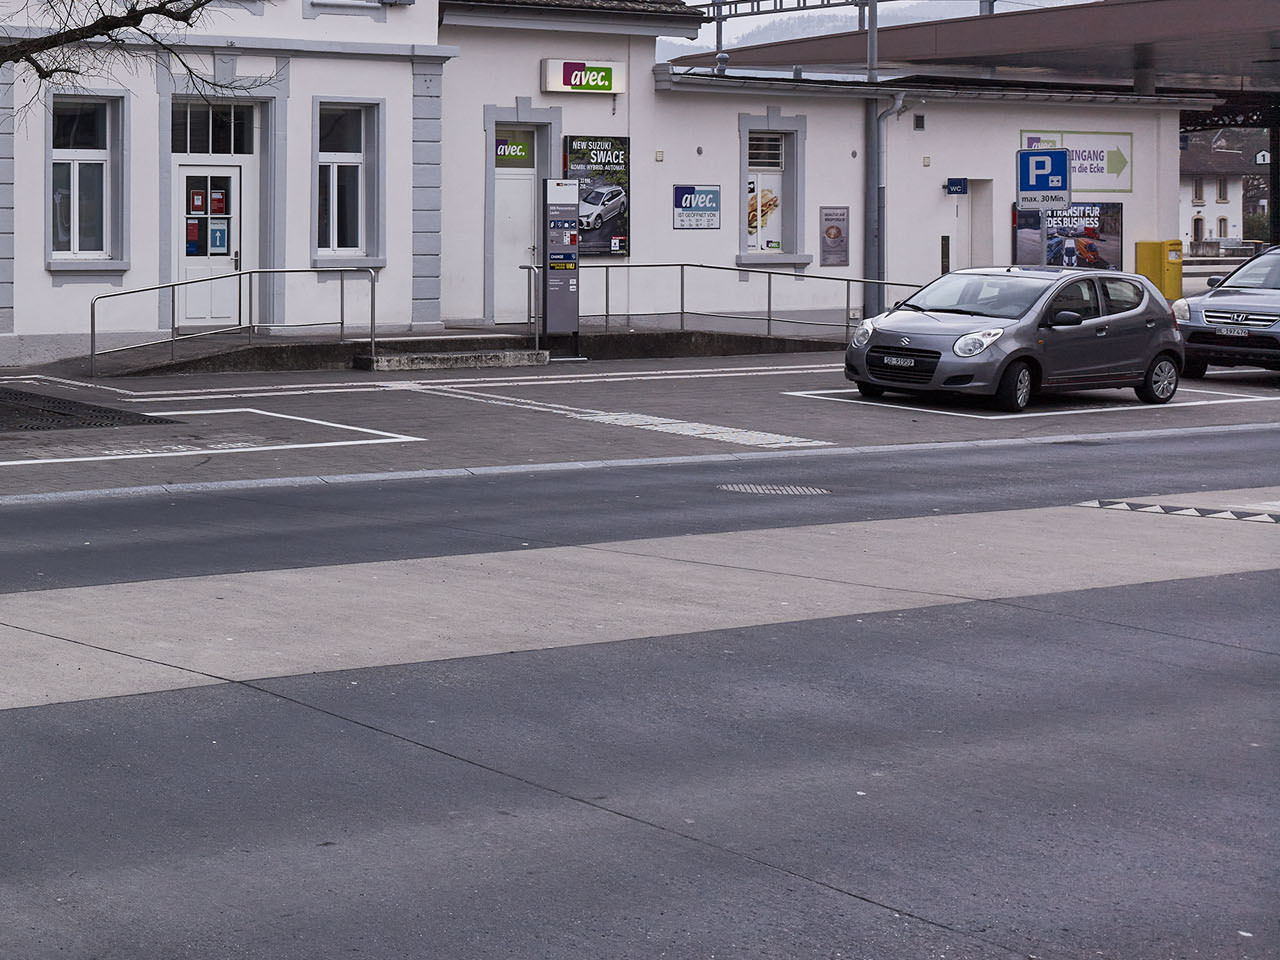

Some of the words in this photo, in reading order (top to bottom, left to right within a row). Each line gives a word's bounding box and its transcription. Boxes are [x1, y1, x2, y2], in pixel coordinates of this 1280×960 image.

[571, 70, 609, 86] avec.
[497, 144, 525, 156] avec.
[572, 141, 587, 149] NEW
[588, 141, 612, 150] SUZUKI
[590, 150, 625, 163] SWACE
[1071, 149, 1105, 162] INGANG
[1261, 154, 1266, 162] 1
[1029, 156, 1052, 185] P
[1078, 164, 1088, 173] die
[1089, 163, 1105, 173] Ecke
[681, 194, 716, 207] avec.
[1041, 195, 1049, 203] 30
[1053, 207, 1085, 216] TRANSIT
[1085, 206, 1100, 217] FÜR
[1063, 218, 1099, 228] BUSINESS
